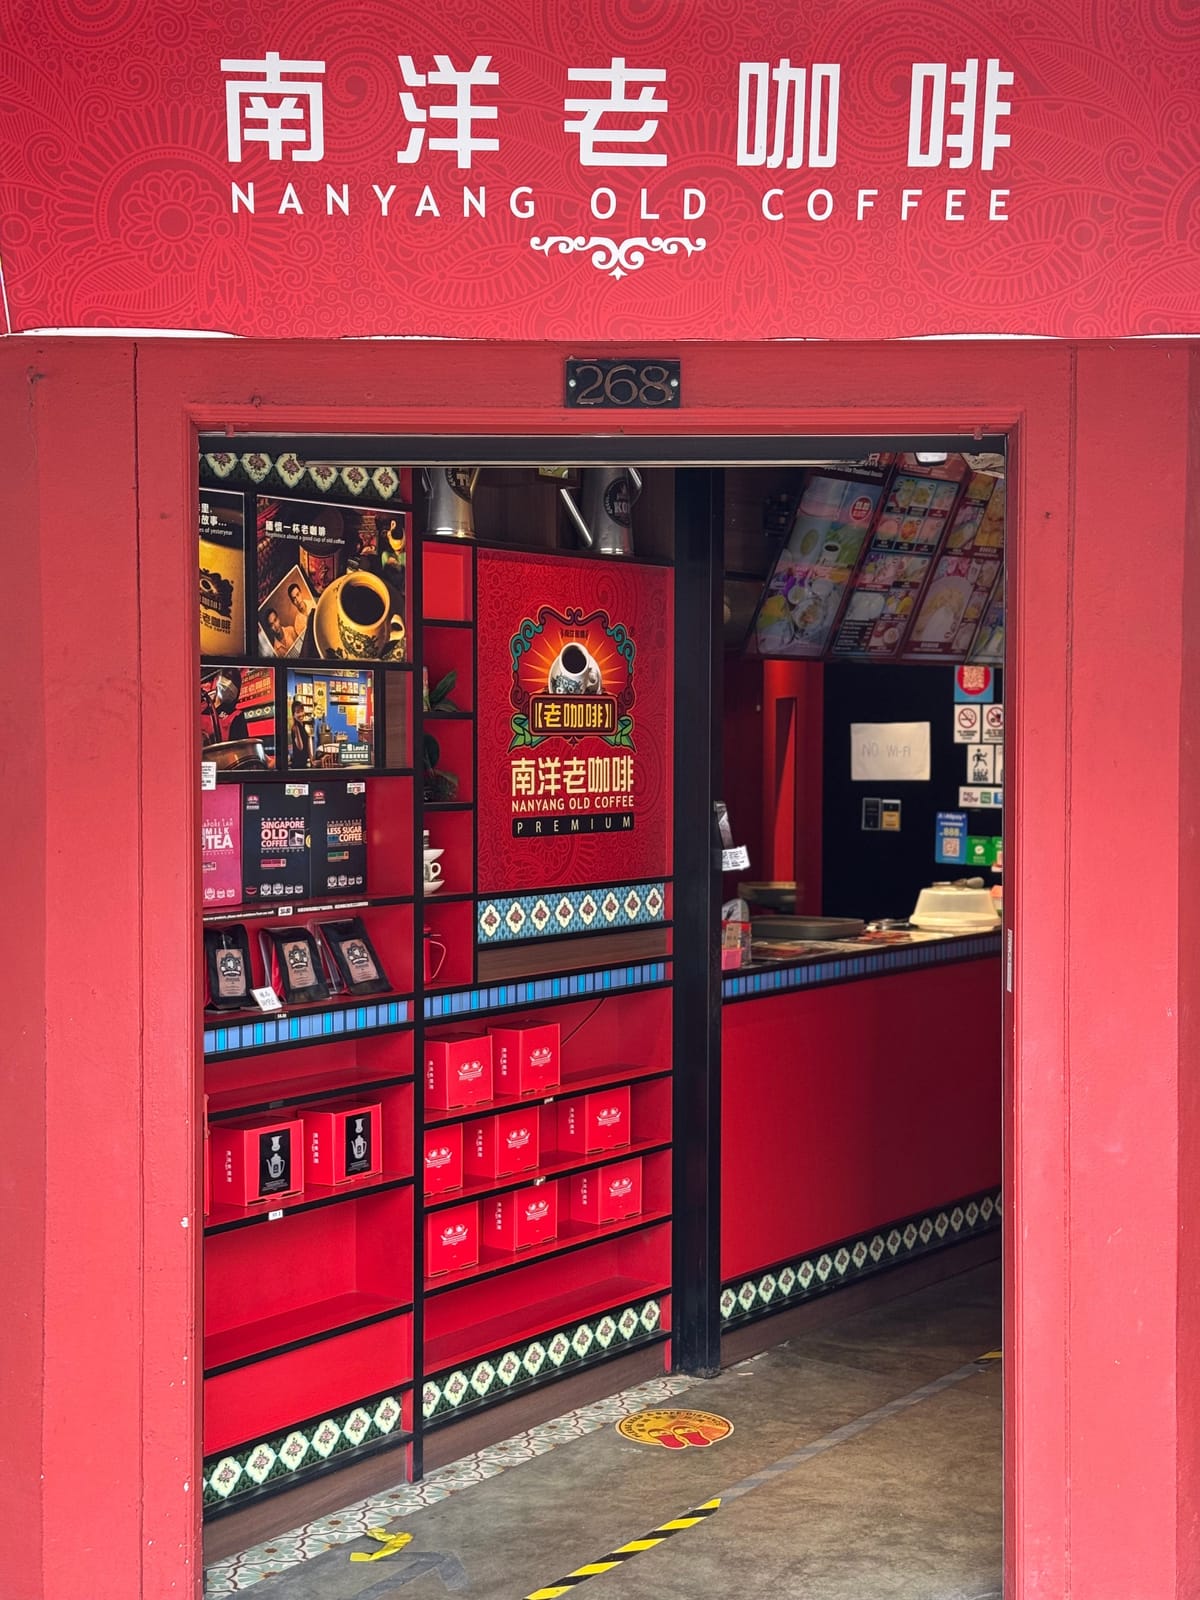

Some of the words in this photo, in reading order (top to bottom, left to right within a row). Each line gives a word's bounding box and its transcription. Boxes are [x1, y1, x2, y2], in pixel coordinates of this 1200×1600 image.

[220, 51, 1015, 170] 南洋老咖啡
[231, 181, 535, 219] NANYANG
[590, 186, 707, 221] OLD
[761, 188, 1011, 222] COFFEE
[576, 364, 673, 405] 268
[862, 742, 879, 758] NO
[511, 755, 634, 797] 南洋老咖啡
[511, 798, 565, 813] NANYANG
[569, 797, 590, 810] OLD
[594, 795, 634, 809] COFFEE
[205, 827, 230, 835] MILK
[261, 820, 305, 830] SINGAPORE
[327, 827, 342, 835] LESS
[342, 825, 362, 834] SUGAR
[517, 815, 631, 835] PREMIUM
[205, 834, 234, 850] TEA
[261, 829, 288, 840] OLD
[339, 832, 362, 842] COFFEE
[261, 839, 288, 848] COFFEE
